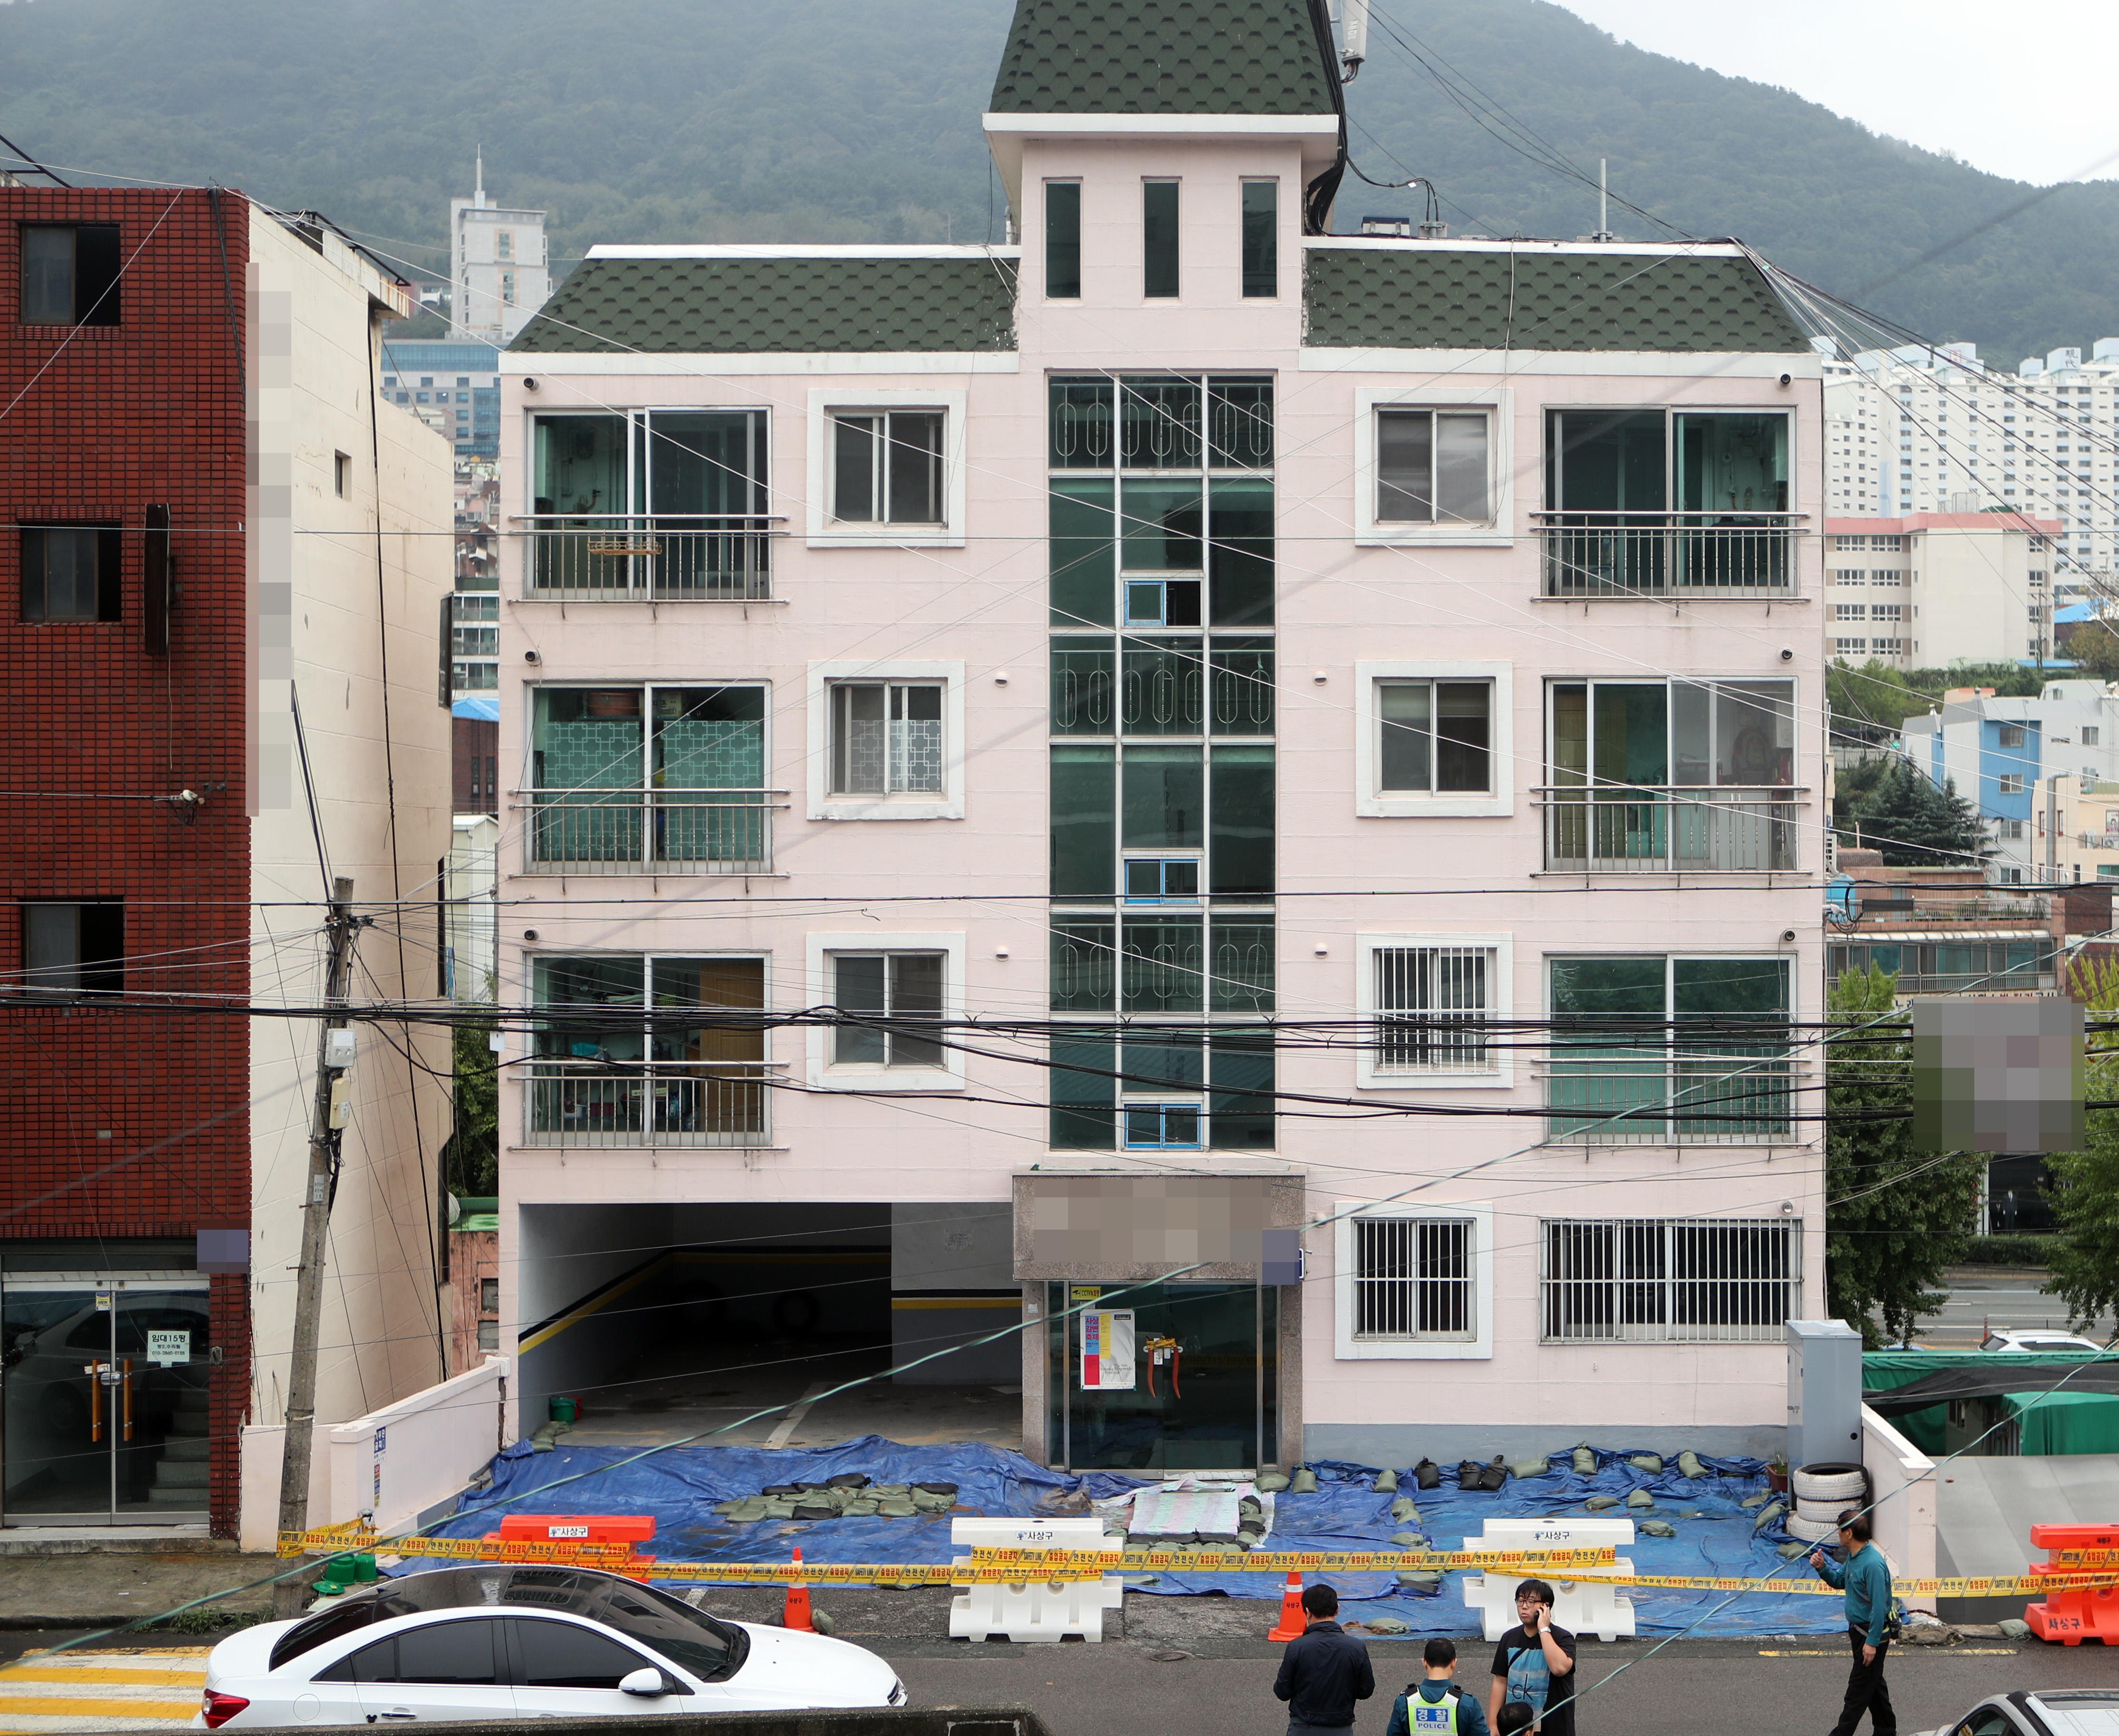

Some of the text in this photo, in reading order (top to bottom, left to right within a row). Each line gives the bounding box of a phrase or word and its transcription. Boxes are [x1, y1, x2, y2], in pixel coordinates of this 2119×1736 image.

[561, 1527, 586, 1536] 사상구
[1027, 1532, 1053, 1540] 사상구
[1545, 1531, 1570, 1540] 사상구
[306, 1534, 325, 1544] 출입금지
[356, 1537, 375, 1547] 출입금지
[406, 1540, 426, 1549] 출입금지
[457, 1542, 475, 1552] 출입금지
[481, 1543, 492, 1552] SAFETY
[507, 1545, 526, 1554] 출입금지
[557, 1546, 576, 1555] 출입금지
[999, 1550, 1018, 1559] 출입금지
[1023, 1551, 1034, 1560] SAFETY
[1049, 1552, 1068, 1561] 출입금지
[1099, 1553, 1119, 1562] 출입금지
[1124, 1554, 1135, 1563] SAFETY
[1150, 1555, 1168, 1563] 출입금지
[1200, 1555, 1219, 1564] 출입금지
[1225, 1555, 1236, 1564] SAFETY
[1251, 1555, 1270, 1564] 출입금지
[1301, 1555, 1320, 1564] 출입금지
[1351, 1555, 1370, 1564] 출입금지
[1402, 1555, 1420, 1564] 출입금지
[1426, 1555, 1437, 1564] SAFETY
[1452, 1555, 1470, 1563] 출입금지
[1502, 1553, 1521, 1562] 출입금지
[1526, 1553, 1537, 1561] SAFETY
[1552, 1552, 1570, 1561] 출입금지
[2062, 1552, 2072, 1560] SAFETY
[2087, 1552, 2105, 1561] 출입금지
[779, 1567, 799, 1575] 출입금지
[830, 1568, 849, 1576] 출입금지
[855, 1568, 866, 1576] SAFETY
[881, 1568, 900, 1577] 출입금지
[931, 1568, 951, 1577] 출입금지
[1718, 1581, 1737, 1589] 출입금지
[1768, 1582, 1787, 1590] 출입금지
[1793, 1583, 1804, 1591] SAFETY
[1894, 1582, 1904, 1591] SAFETY
[1919, 1582, 1938, 1591] 출입금지
[1970, 1580, 1988, 1589] 출입금지
[1995, 1580, 2005, 1588] SAFETY
[2020, 1578, 2039, 1588] 출입금지
[2070, 1576, 2089, 1585] 출입금지
[2049, 1618, 2080, 1630] 사상구
[1512, 1673, 1534, 1701] ck
[1417, 1709, 1447, 1721] 경찰
